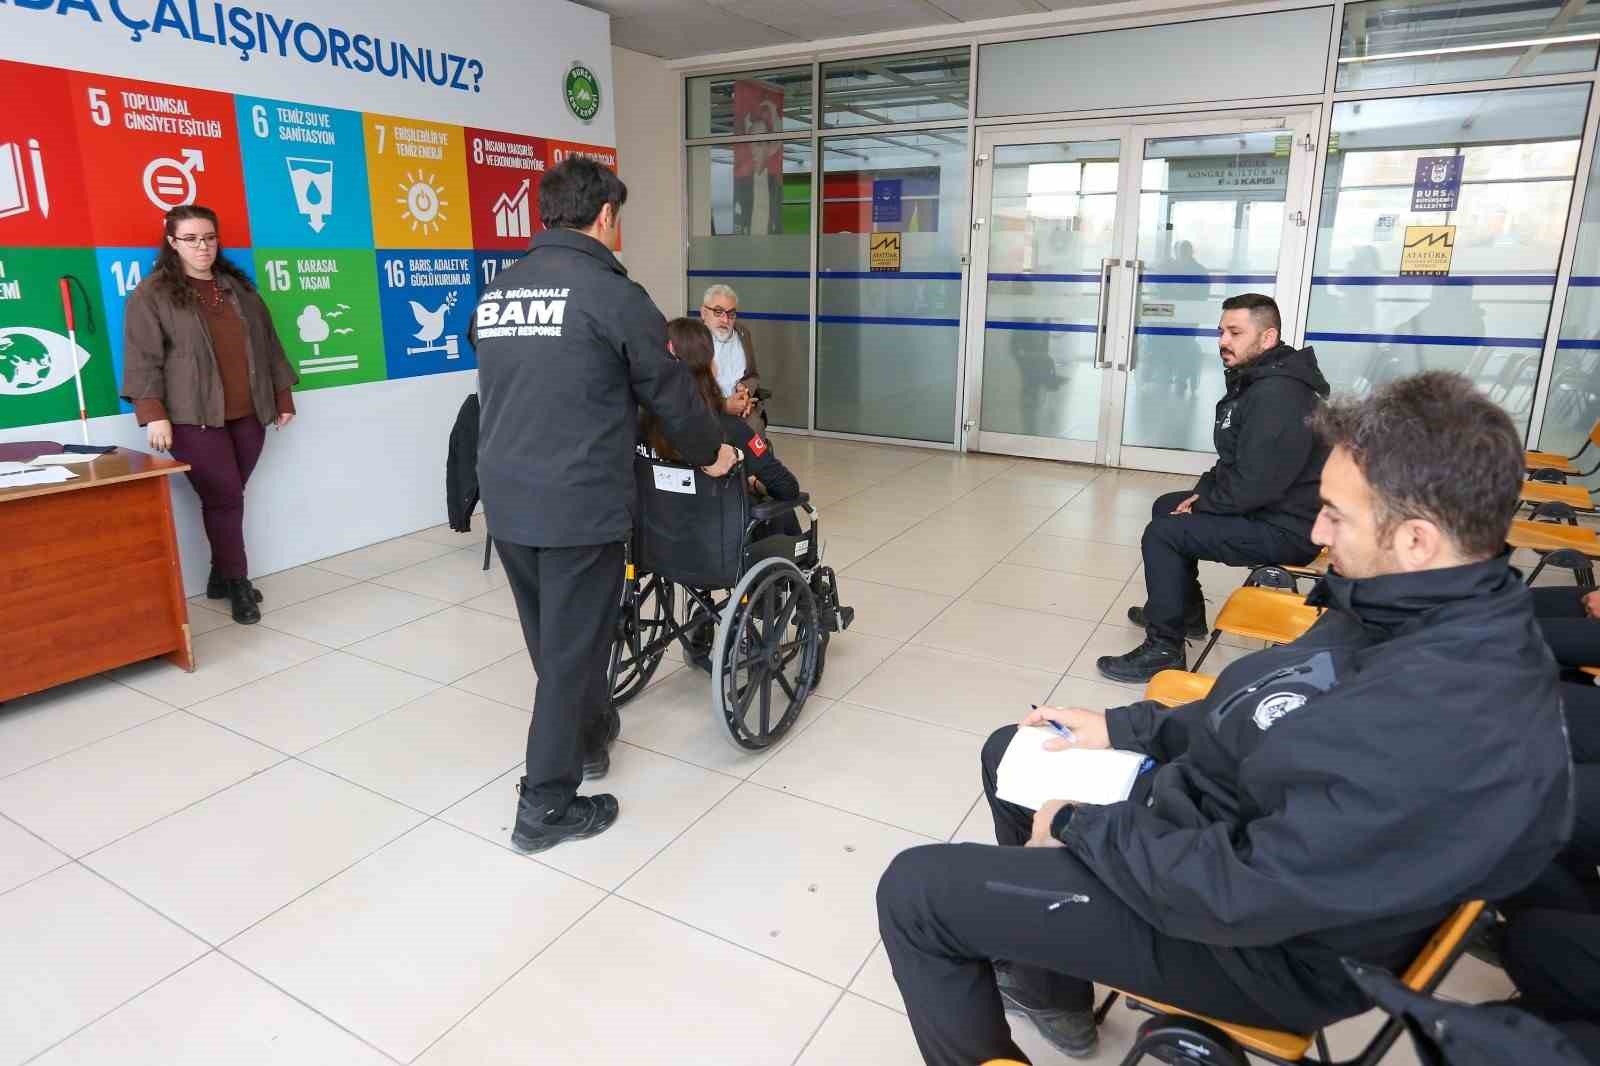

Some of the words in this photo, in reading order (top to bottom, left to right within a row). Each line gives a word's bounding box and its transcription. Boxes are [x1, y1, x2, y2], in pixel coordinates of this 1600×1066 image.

[109, 0, 484, 93] ÇALIŞIYORSUNUZ?
[87, 87, 111, 127] 5
[120, 91, 192, 115] TOPLUMSAL
[124, 111, 177, 134] CİNSİYET
[178, 118, 222, 138] EŞİTLİĞİ
[252, 104, 269, 138] 6
[276, 107, 304, 124] TEMİZ
[305, 111, 317, 126] SU
[317, 113, 330, 127] VE
[279, 125, 336, 145] SANİTASYON
[375, 125, 385, 154] 7
[473, 137, 484, 164] 8
[265, 260, 291, 292] 15
[296, 259, 339, 273] KARASAL
[384, 259, 406, 288] 16
[434, 259, 459, 271] ADALET
[459, 259, 469, 271] VE
[482, 259, 497, 285] 17
[111, 260, 142, 297] 14
[299, 275, 331, 292] YAŞAM
[410, 272, 434, 287] GÜÇLÜ
[434, 273, 471, 286] KURUMLAR
[505, 287, 571, 299] MÜDAHALE
[477, 300, 567, 328] BAM
[518, 326, 562, 337] RESPONSE
